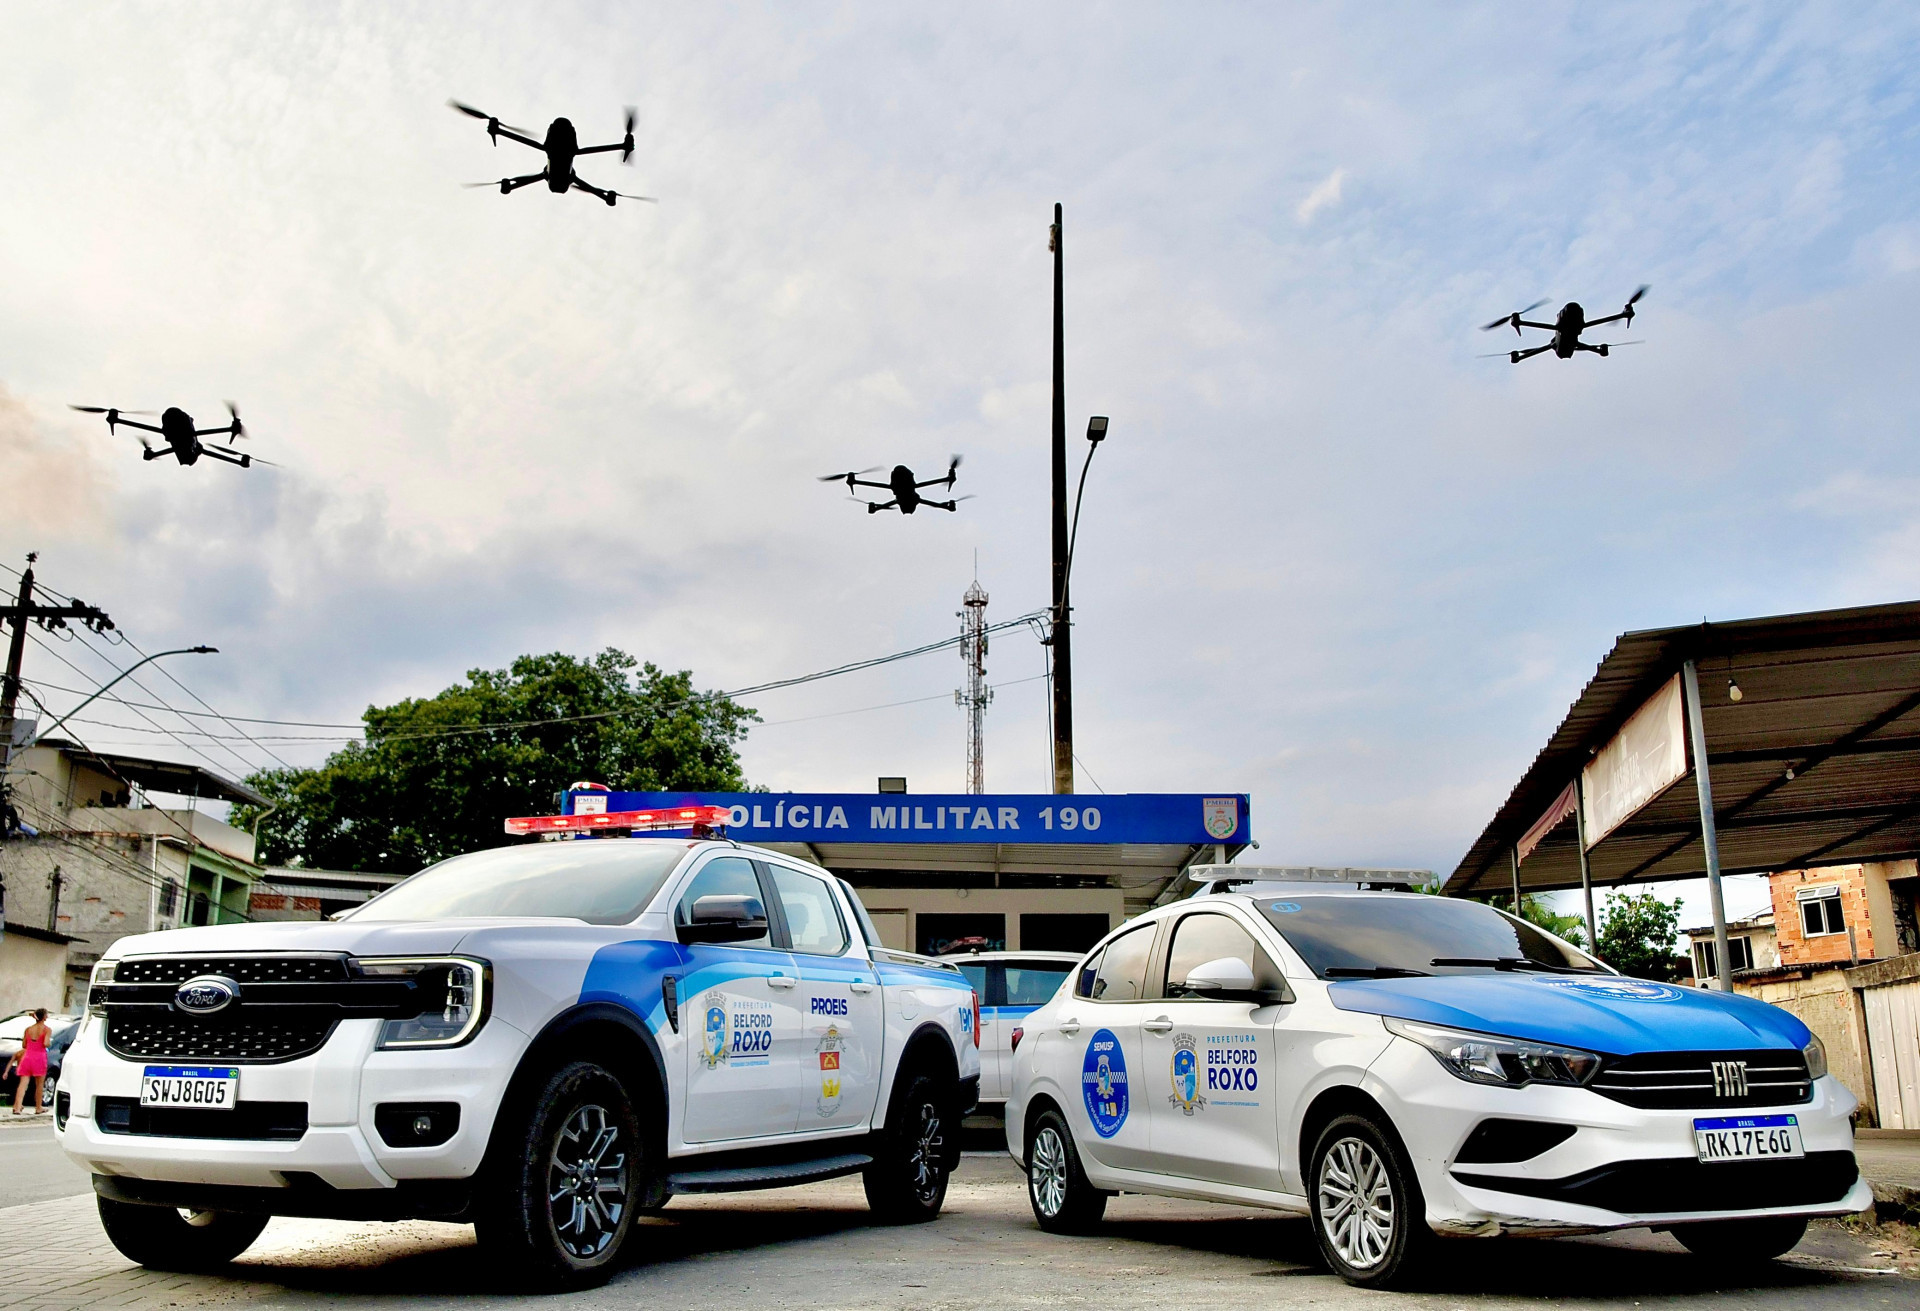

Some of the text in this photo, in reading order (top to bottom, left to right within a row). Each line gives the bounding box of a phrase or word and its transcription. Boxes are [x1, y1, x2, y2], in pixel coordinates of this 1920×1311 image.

[704, 801, 1101, 831] OLÍCIA MILITAR 190
[185, 987, 218, 1005] Ford
[734, 1001, 772, 1009] PREFEITURA
[811, 997, 848, 1015] PROEIS
[734, 1013, 772, 1028] BELFORD
[958, 1007, 973, 1033] 190
[731, 1030, 772, 1052] ROXO
[1206, 1034, 1256, 1044] PREFEITURA
[1207, 1049, 1258, 1065] BELFORD
[1207, 1067, 1258, 1092] ROXO
[1711, 1061, 1748, 1097] FIAT
[149, 1079, 227, 1104] SWJ8G05
[1705, 1129, 1792, 1157] RKI7E60
